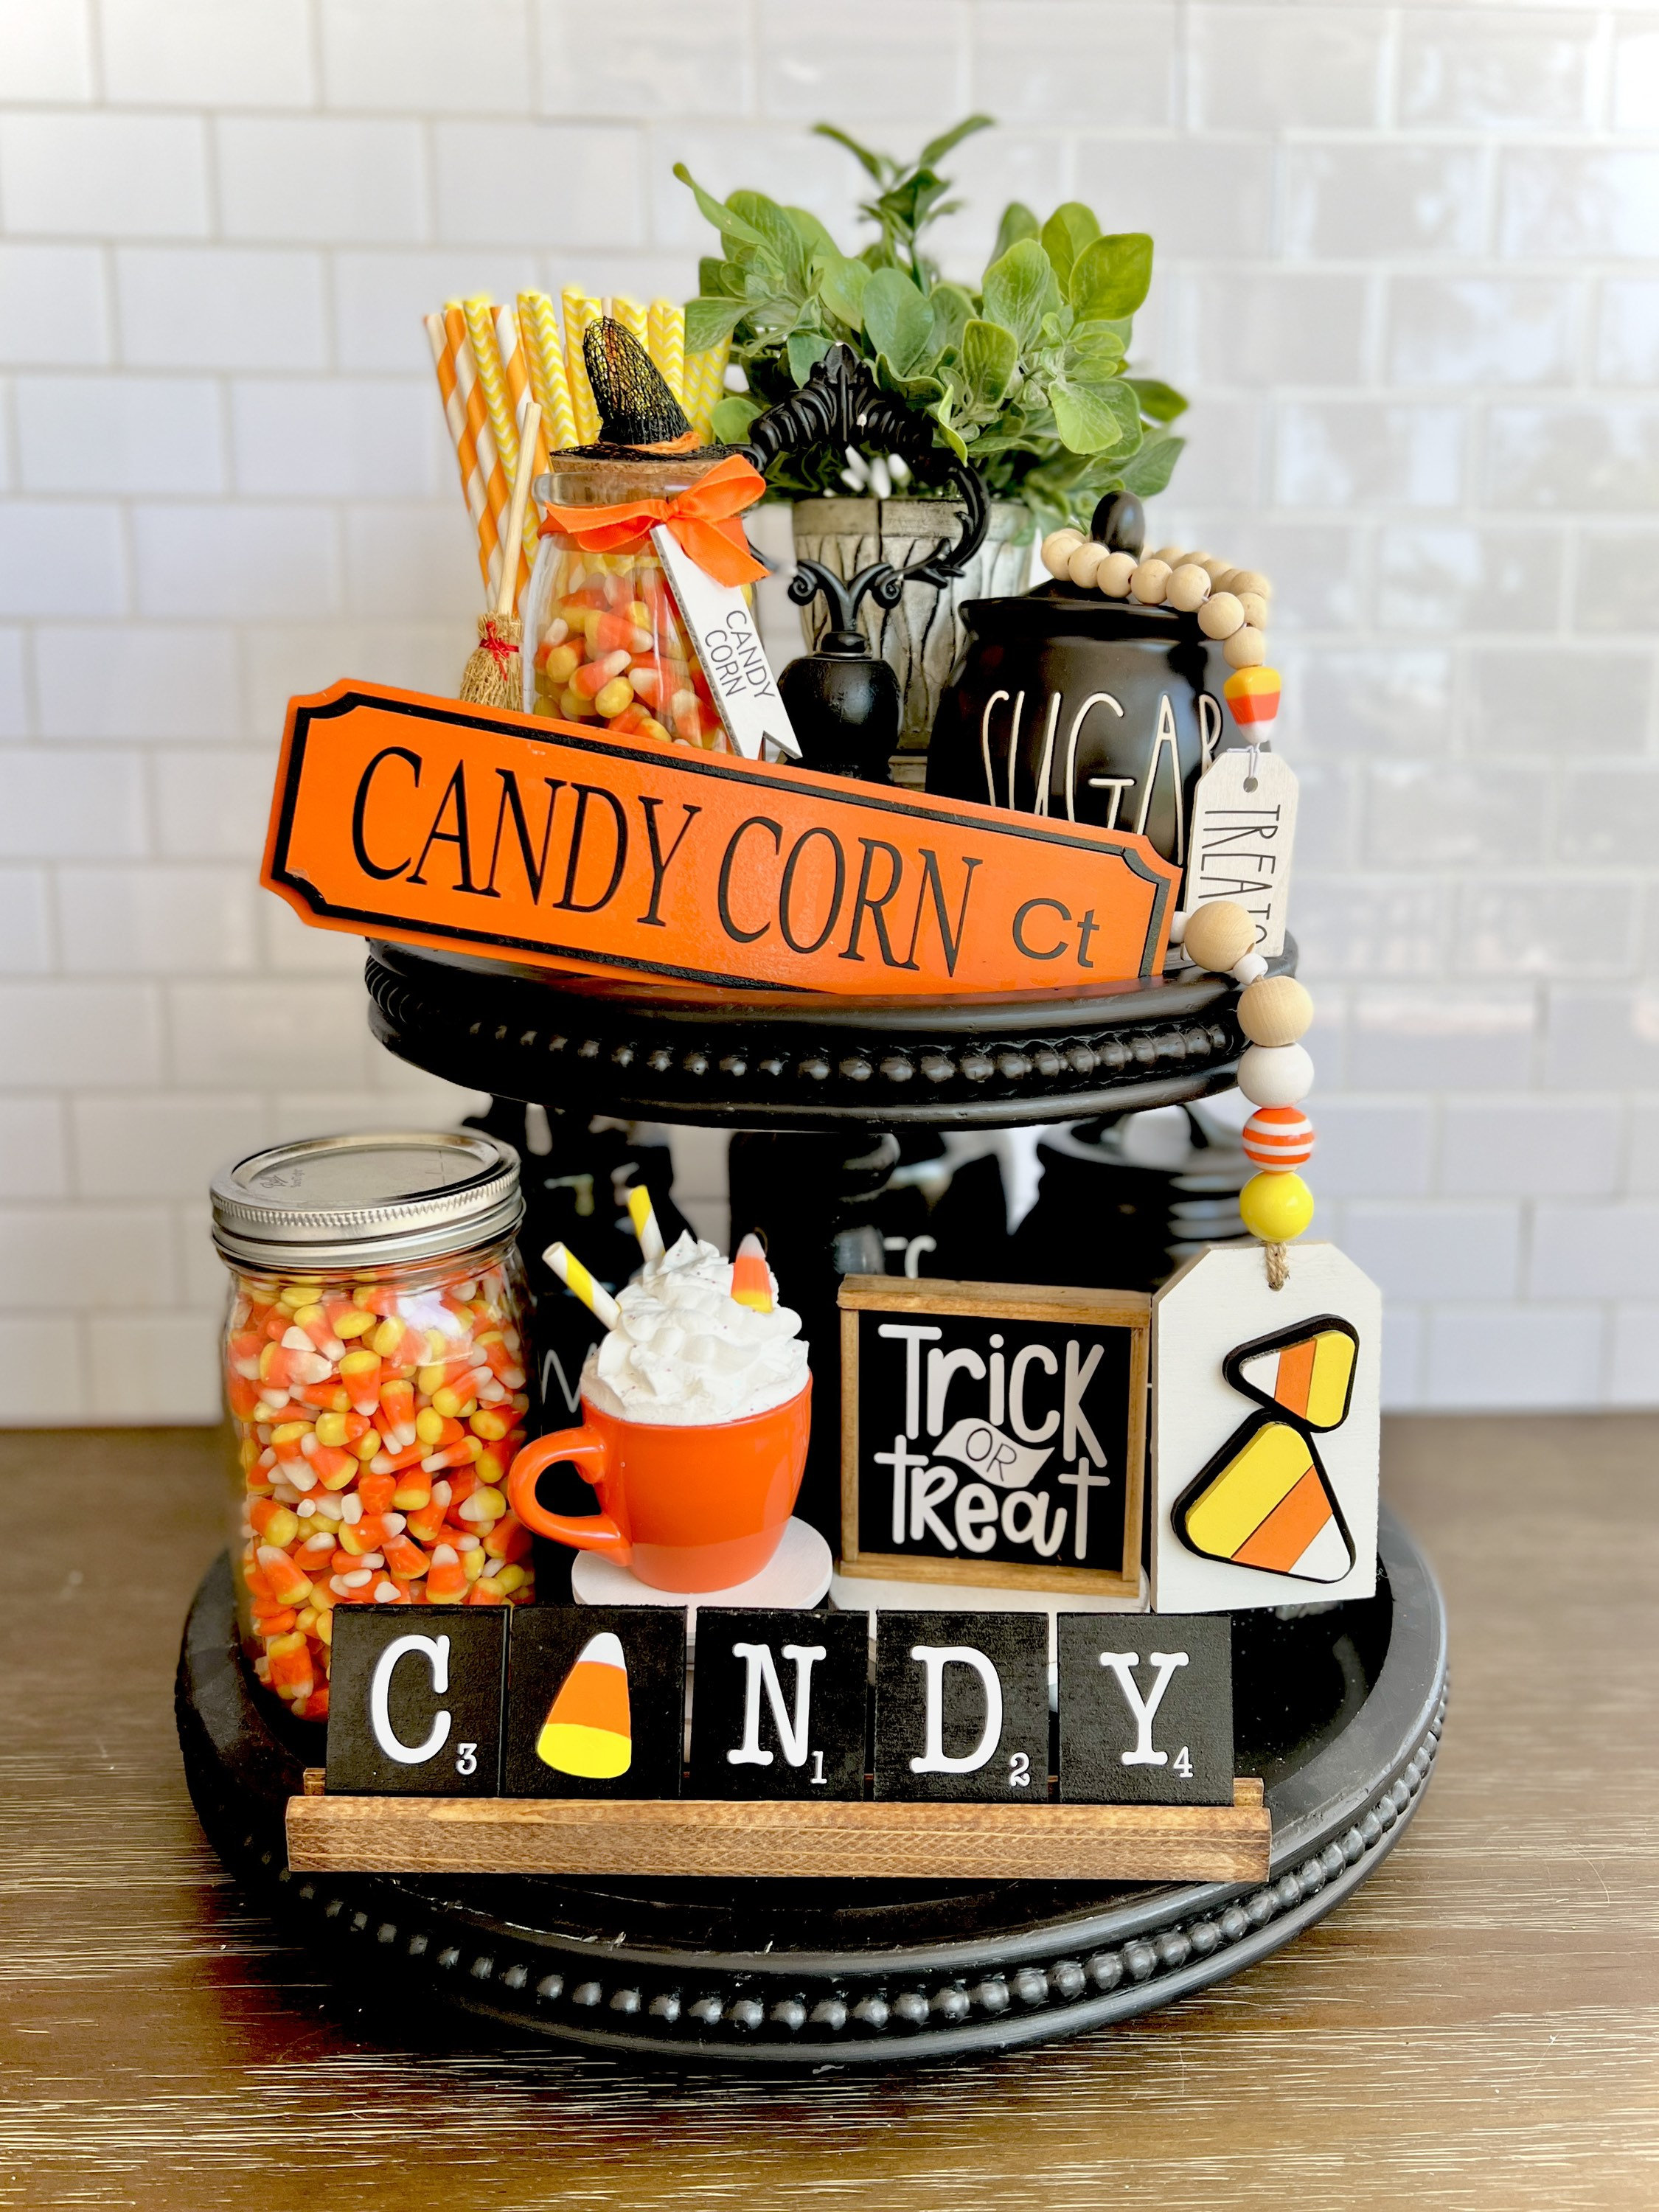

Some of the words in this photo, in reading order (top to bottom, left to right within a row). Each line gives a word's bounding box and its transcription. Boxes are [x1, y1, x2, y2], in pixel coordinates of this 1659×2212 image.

[705, 630, 747, 697] CORN
[726, 611, 776, 698] CANDY
[352, 746, 702, 927] CANDY
[718, 816, 983, 977] CORN
[1013, 898, 1100, 968] Ct
[965, 1428, 1017, 1481] OR
[457, 1743, 477, 1775] 3
[812, 1751, 827, 1784] 1
[1009, 1752, 1029, 1786] 2
[1172, 1746, 1193, 1778] 4
